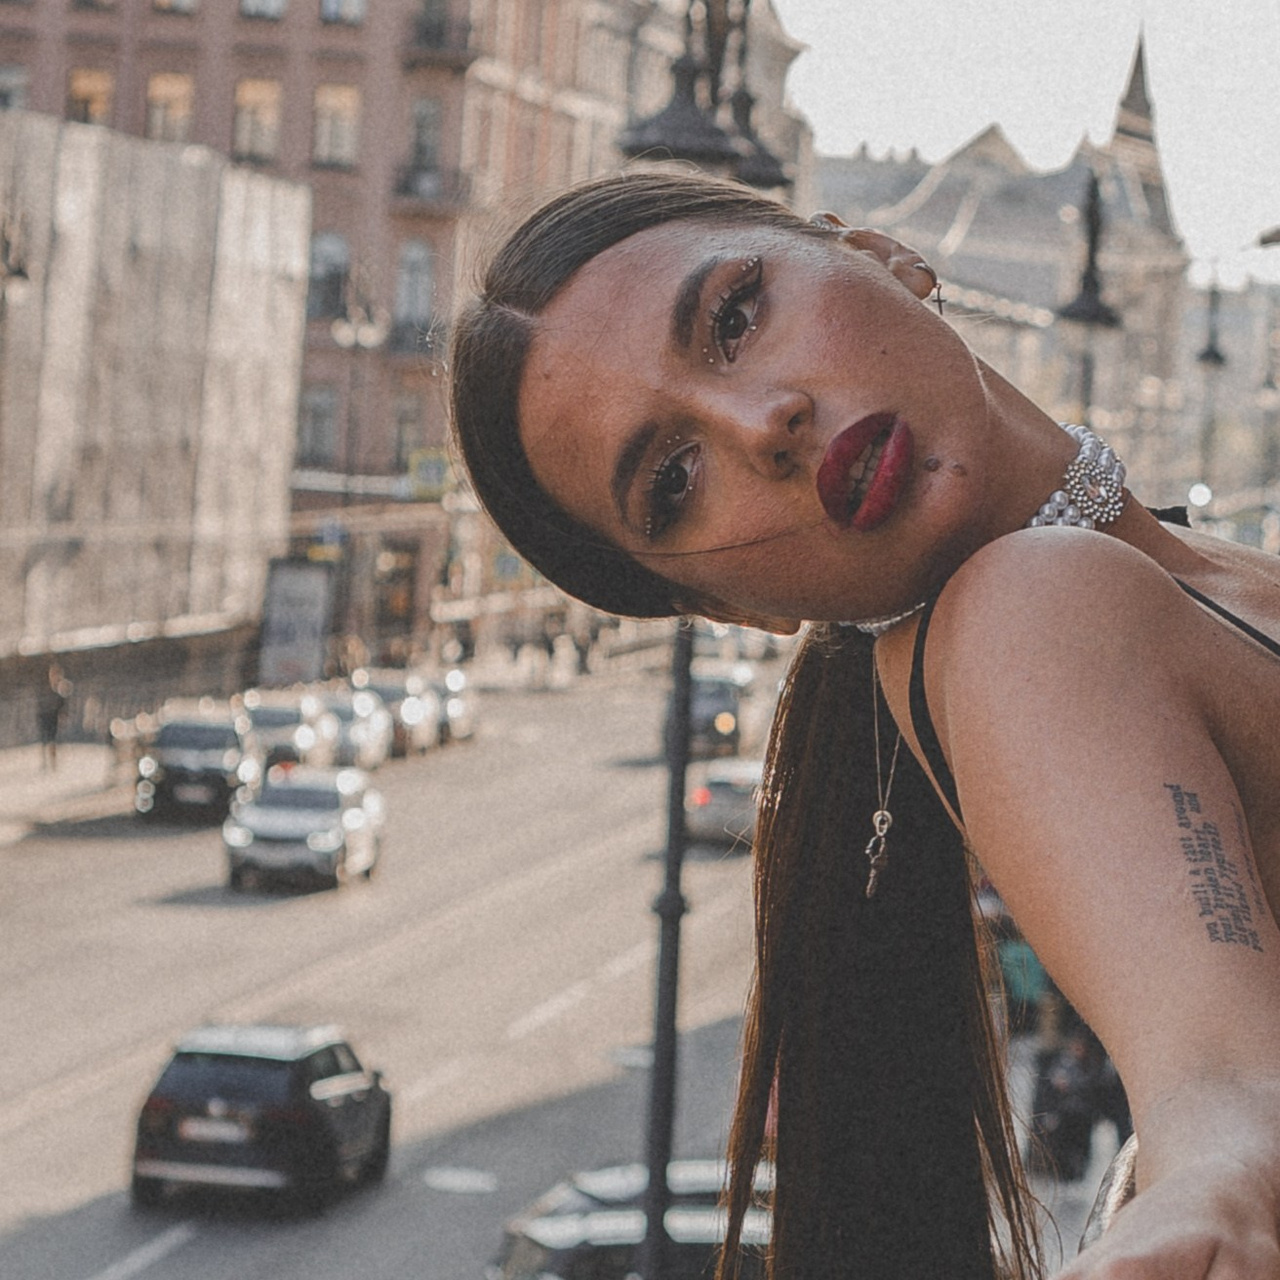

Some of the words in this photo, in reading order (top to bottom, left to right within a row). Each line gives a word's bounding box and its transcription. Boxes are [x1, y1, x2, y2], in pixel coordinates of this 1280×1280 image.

[1162, 782, 1190, 829] around
[1191, 829, 1212, 862] heart
[1203, 867, 1224, 909] broken
